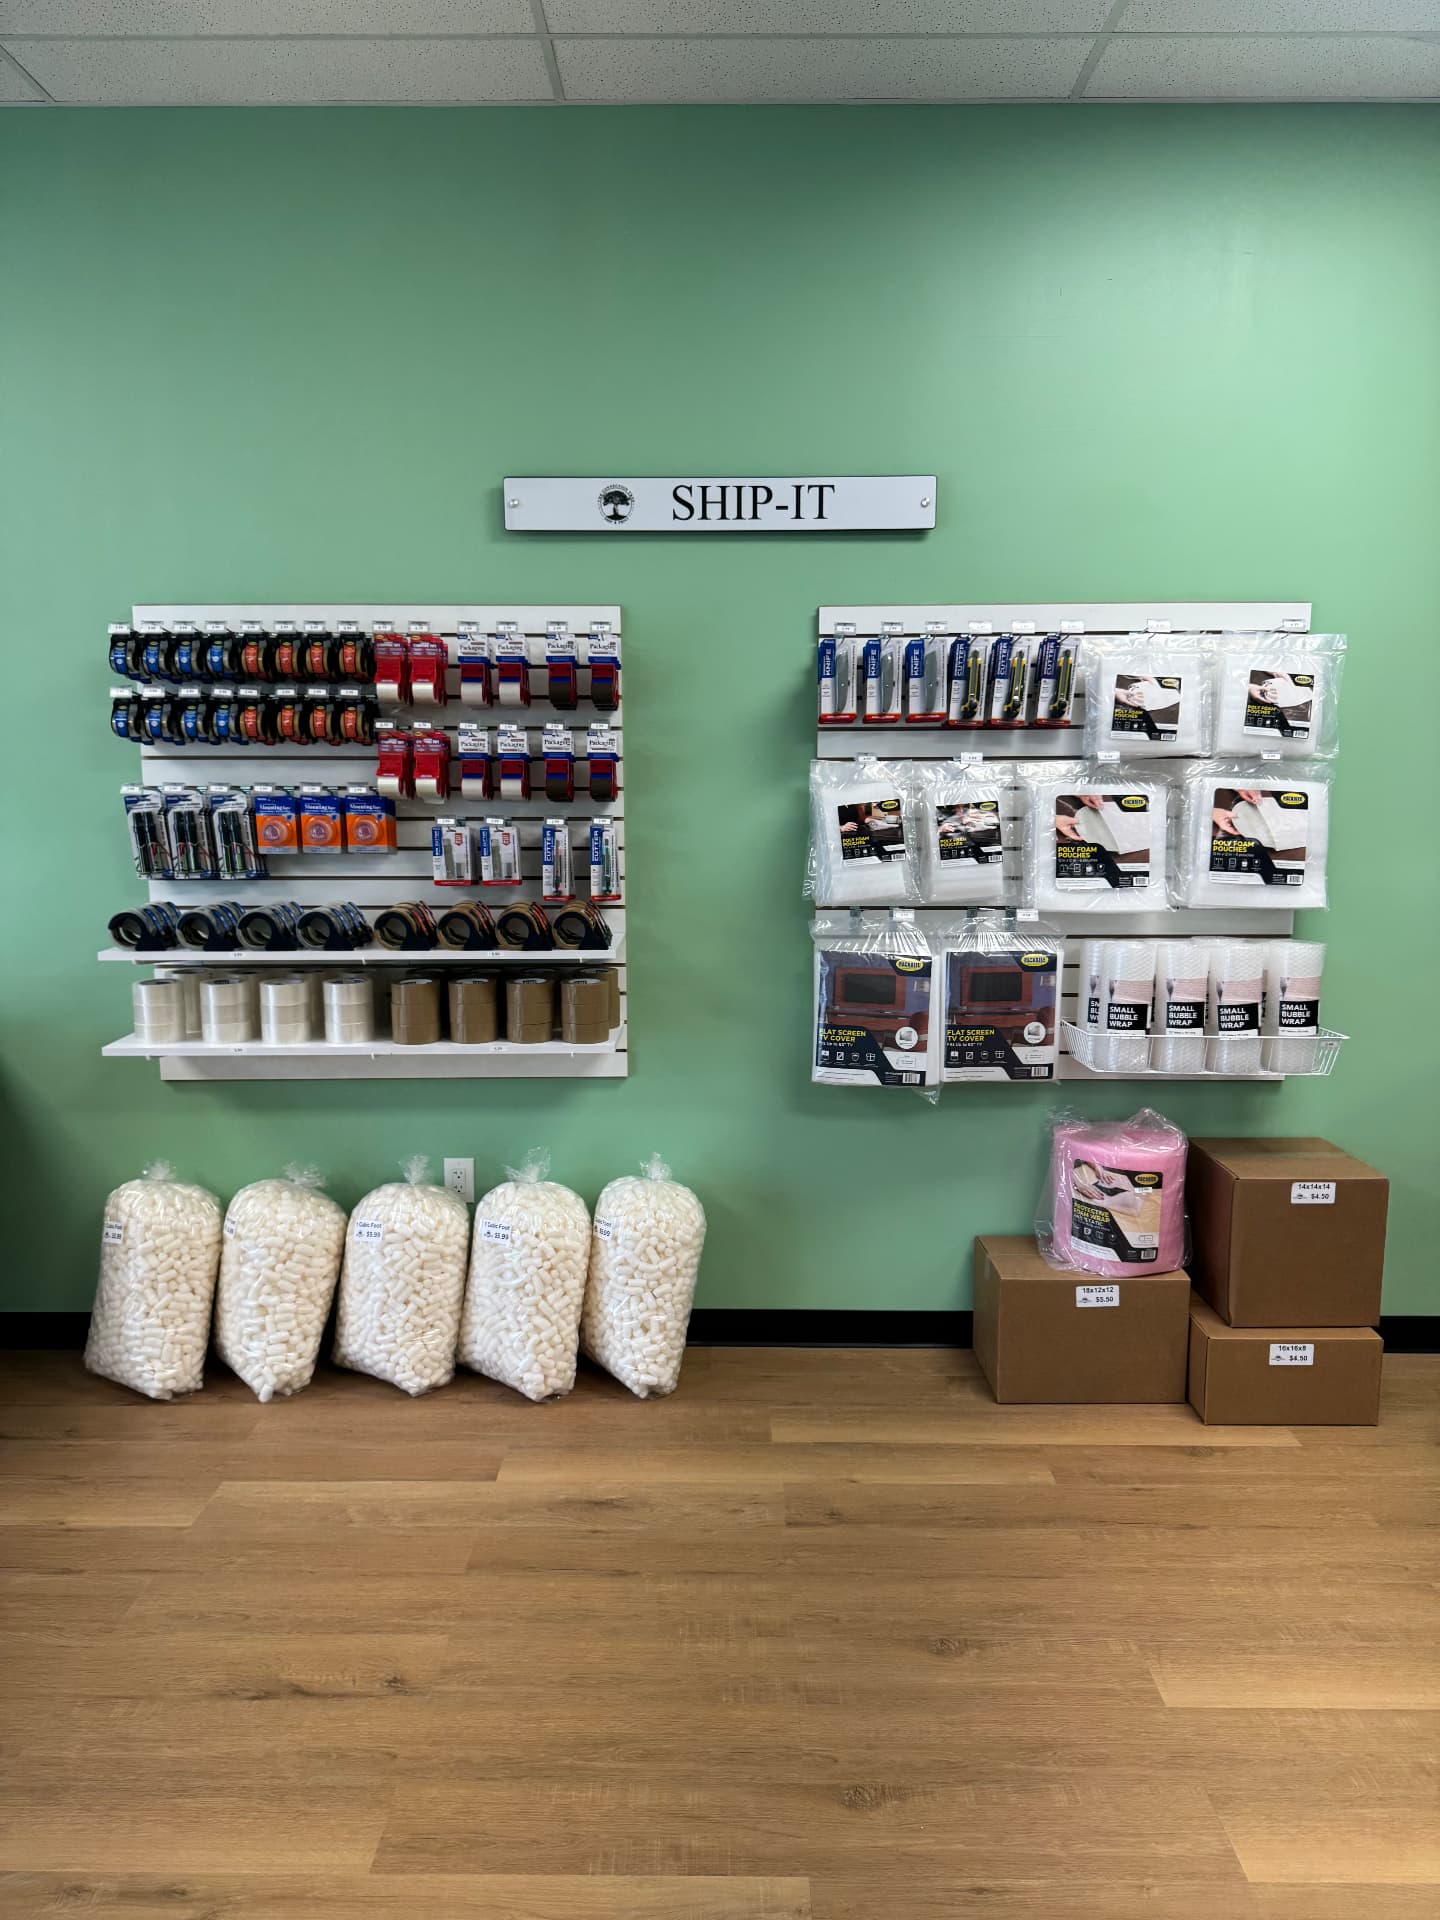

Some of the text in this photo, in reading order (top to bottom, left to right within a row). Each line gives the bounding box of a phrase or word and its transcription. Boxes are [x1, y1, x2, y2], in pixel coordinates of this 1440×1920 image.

[673, 484, 836, 521] SHIP-IT
[1212, 845, 1247, 853] POUCHES
[1109, 1006, 1136, 1014] SMALL
[1168, 1004, 1195, 1012] SMALL
[1219, 1007, 1246, 1015] SMALL
[1109, 1013, 1139, 1021] BUBBLE
[1220, 1014, 1249, 1022] BUBBLE
[1281, 1010, 1311, 1018] BUBBLE
[1108, 1020, 1133, 1028] WRAP
[1220, 1021, 1245, 1029] WRAP
